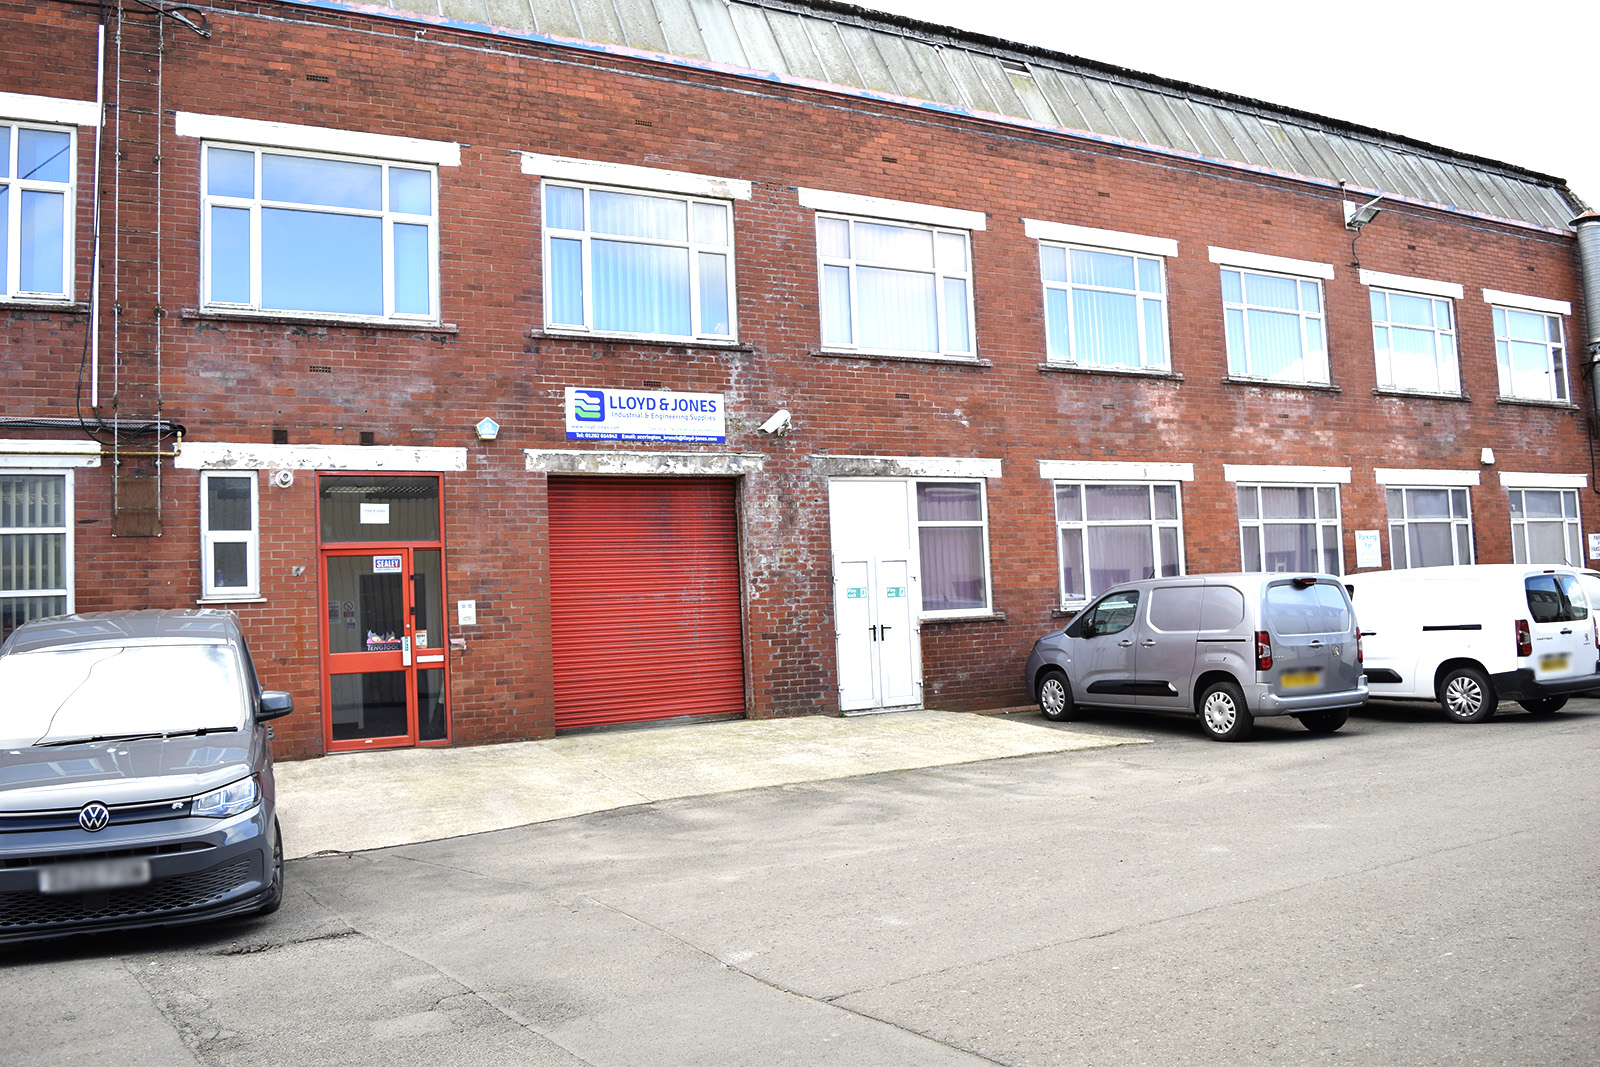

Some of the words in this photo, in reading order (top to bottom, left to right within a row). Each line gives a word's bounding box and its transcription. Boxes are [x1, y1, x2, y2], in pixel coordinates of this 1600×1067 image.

[609, 396, 656, 411] LLOYD
[658, 397, 669, 411] &
[671, 398, 717, 413] JONES
[611, 411, 642, 419] Industrial
[651, 412, 688, 422] Engineering
[689, 413, 716, 423] Supplies
[1358, 533, 1378, 542] Parking
[376, 559, 399, 568] SEALEY
